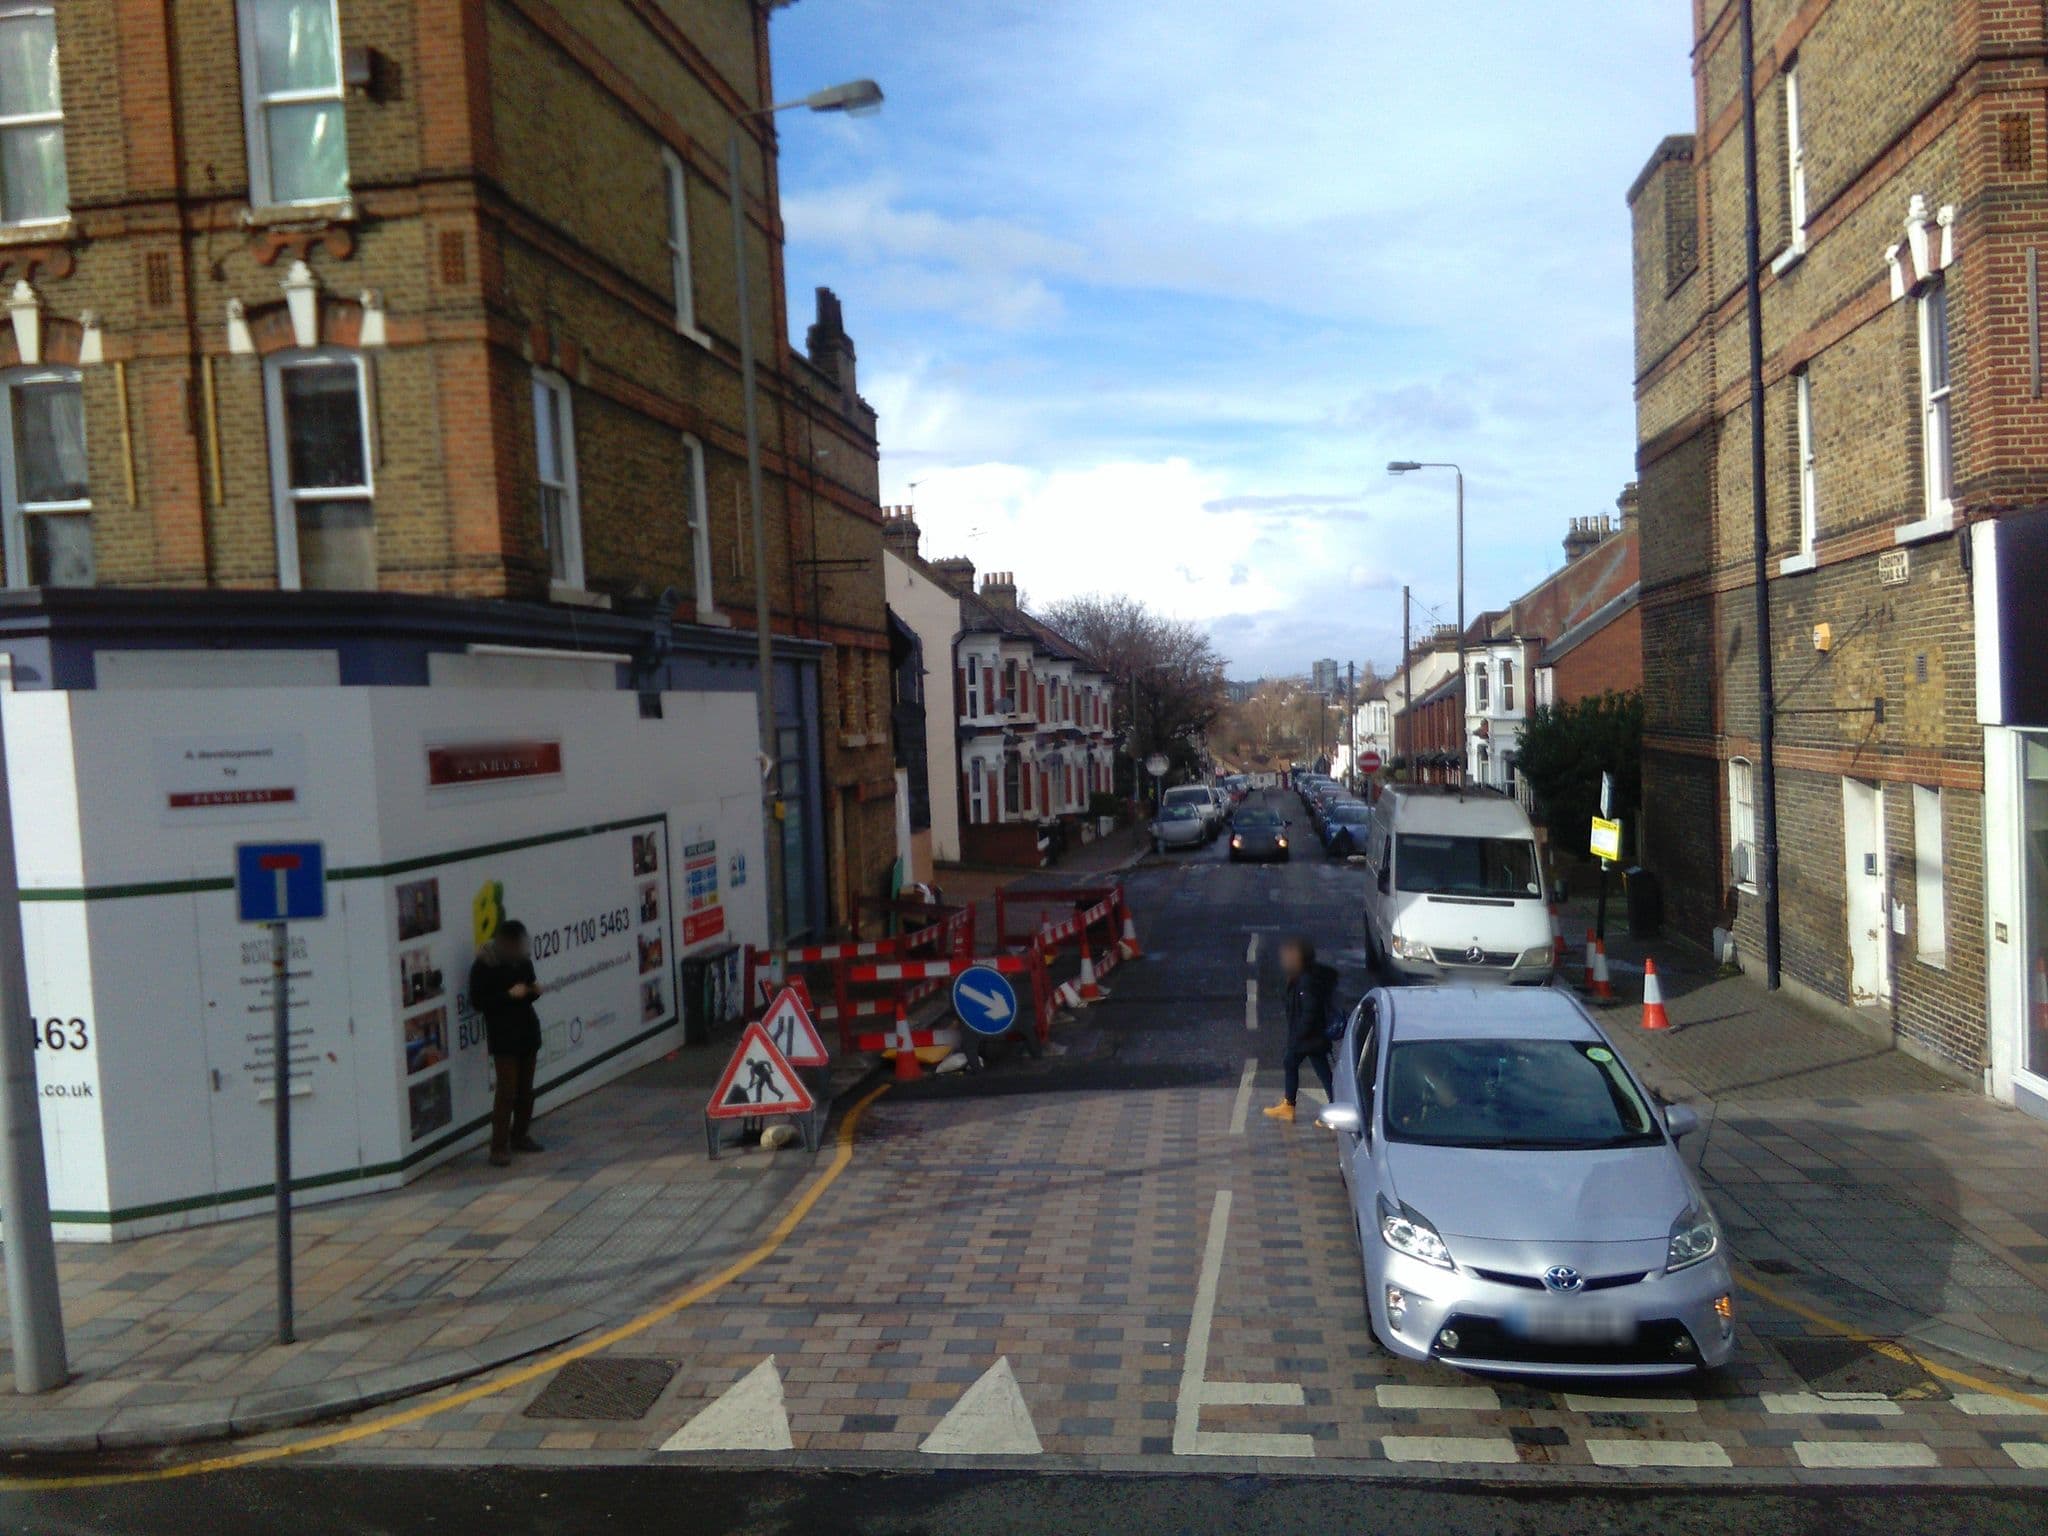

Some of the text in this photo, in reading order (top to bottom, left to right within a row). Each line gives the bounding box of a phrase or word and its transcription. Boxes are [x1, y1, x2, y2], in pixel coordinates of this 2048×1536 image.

[533, 906, 631, 961] 020 7100 5463
